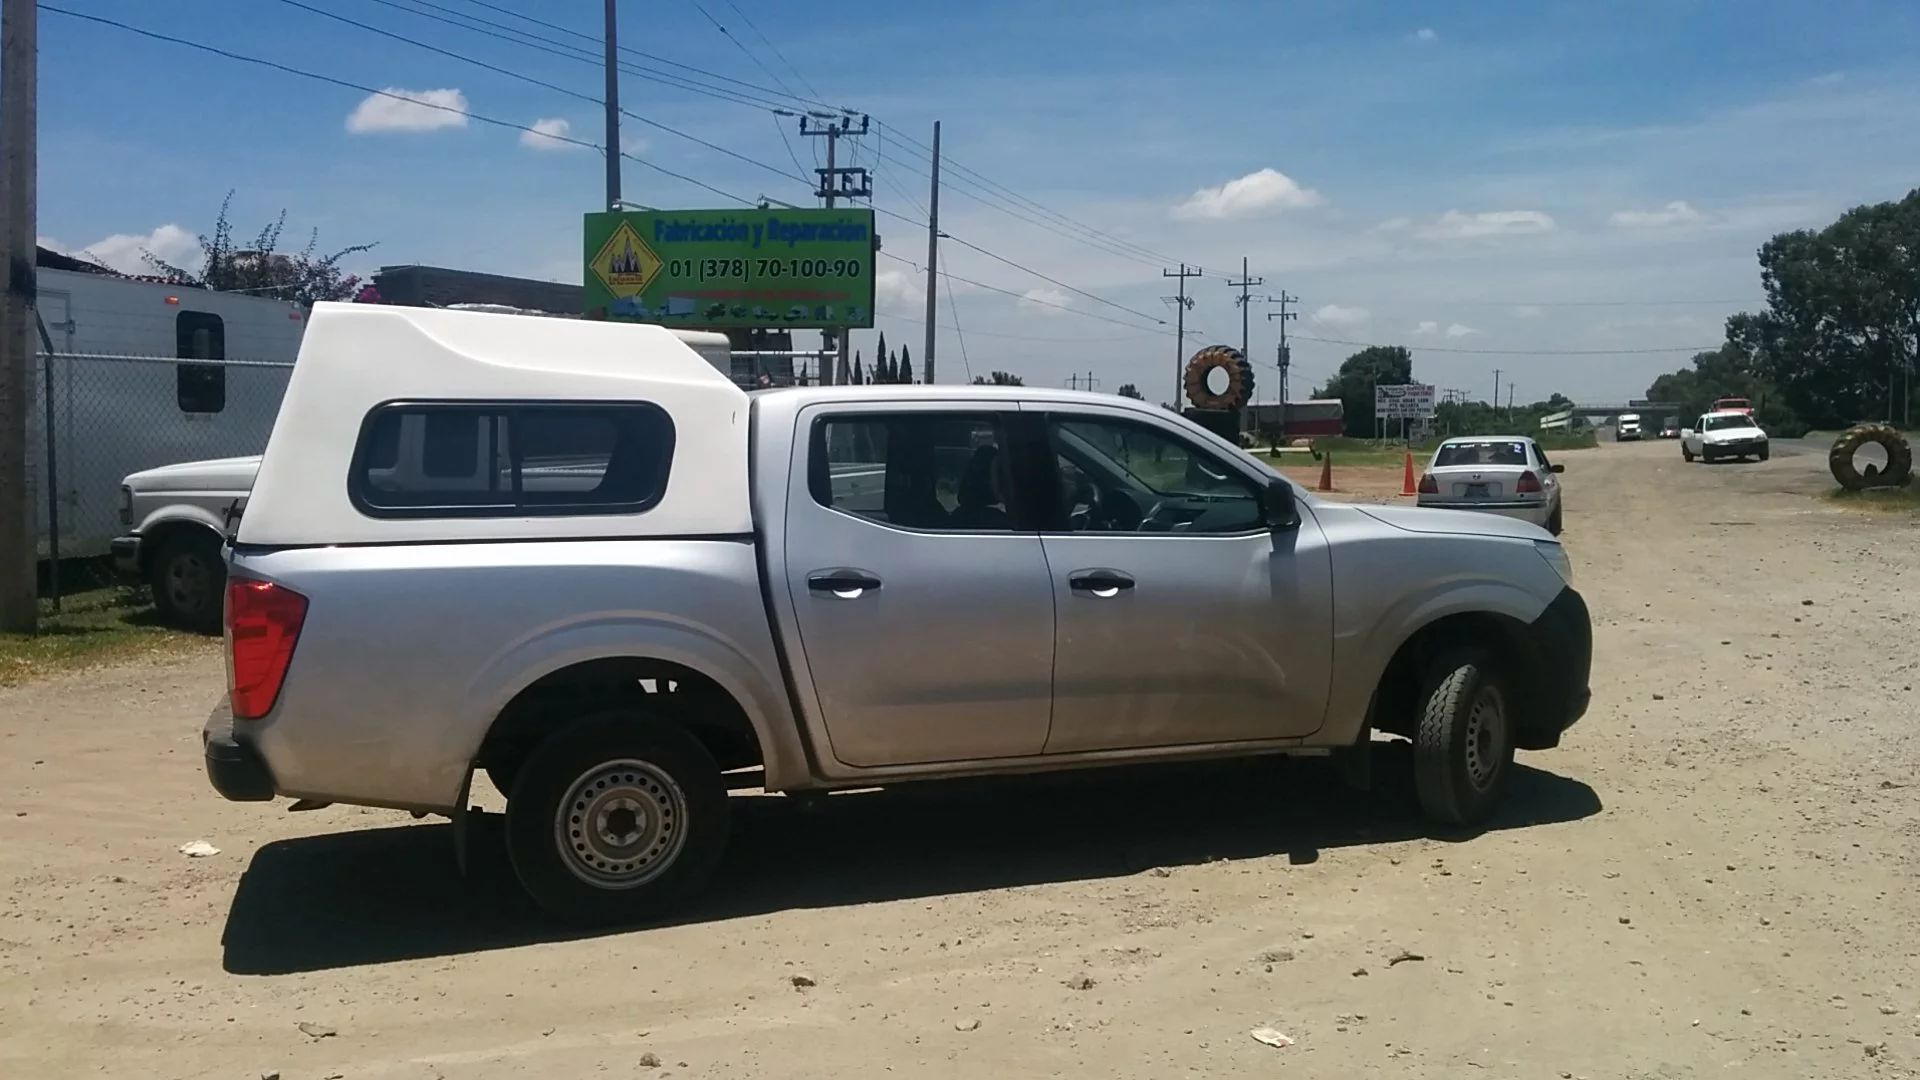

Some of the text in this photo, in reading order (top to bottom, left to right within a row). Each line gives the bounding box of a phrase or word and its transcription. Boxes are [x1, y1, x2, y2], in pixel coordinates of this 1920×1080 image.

[654, 217, 867, 248] Fabricación y Reparación
[669, 259, 861, 283] 01 (378) 70-100-90
